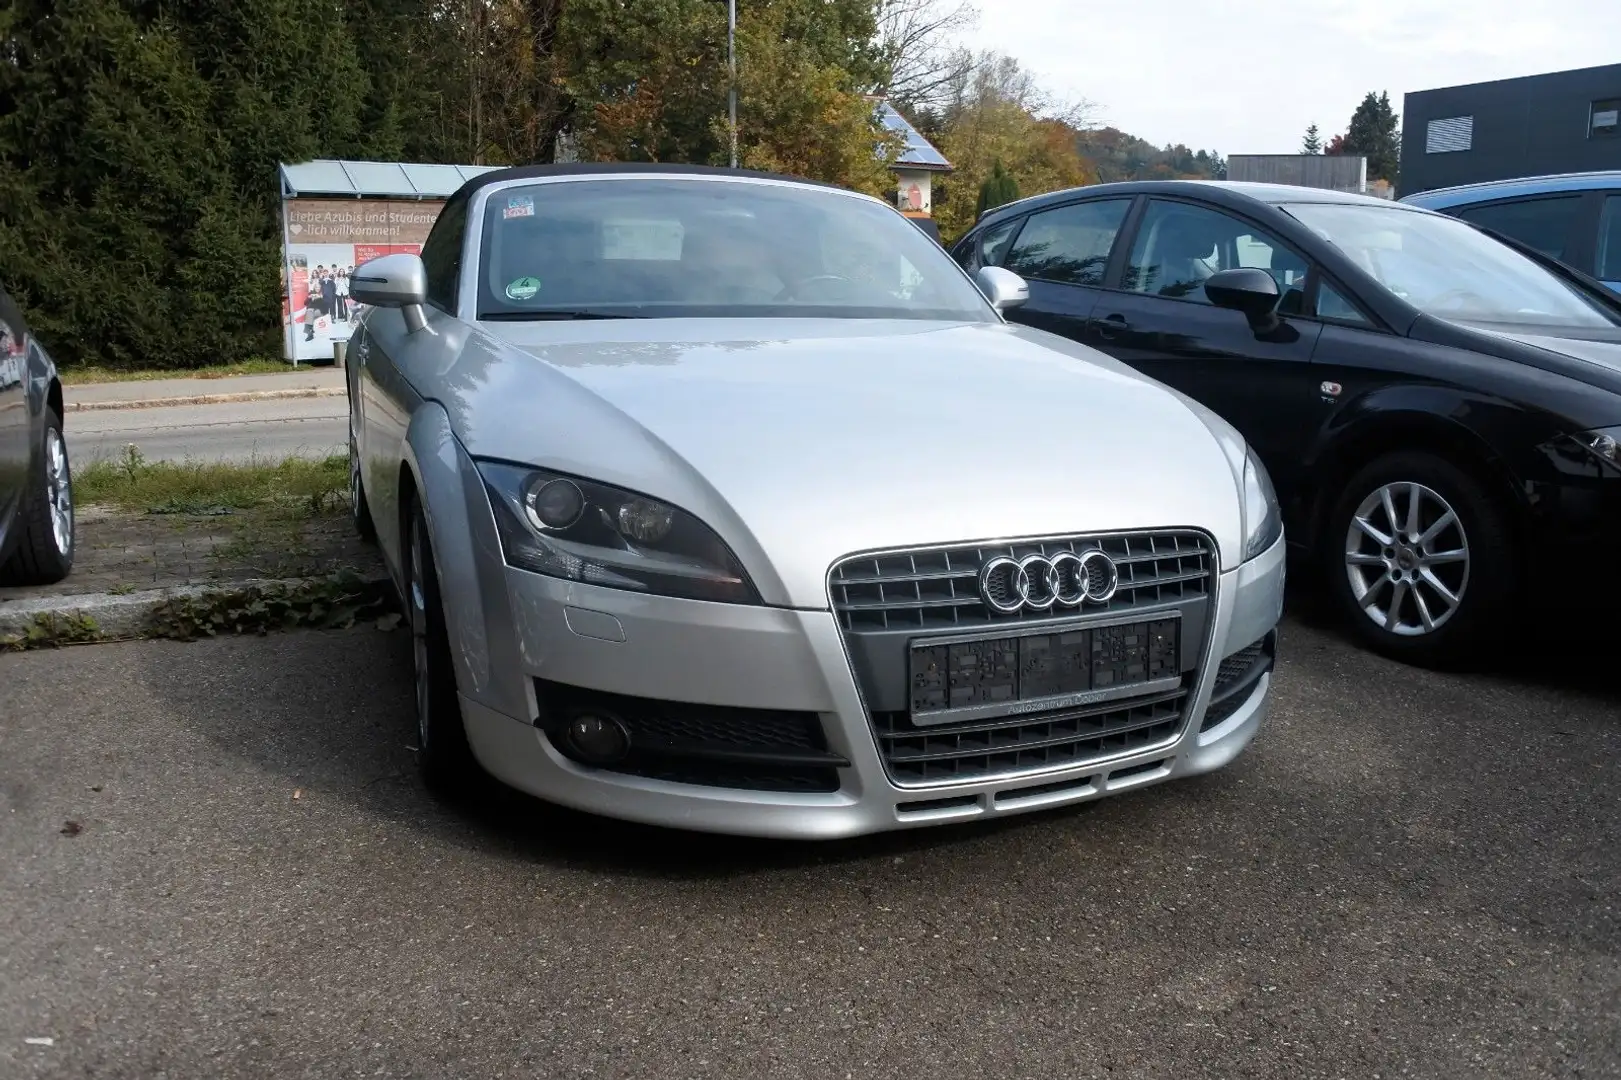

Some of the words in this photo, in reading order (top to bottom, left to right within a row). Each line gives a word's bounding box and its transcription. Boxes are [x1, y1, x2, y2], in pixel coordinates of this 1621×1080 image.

[290, 211, 321, 222] Liebe
[324, 211, 362, 222] Azubis
[365, 212, 387, 222] und
[389, 212, 438, 223] Studente
[331, 224, 400, 236] willkommen!
[520, 277, 530, 288] 4
[1007, 698, 1073, 715] Autozentrum
